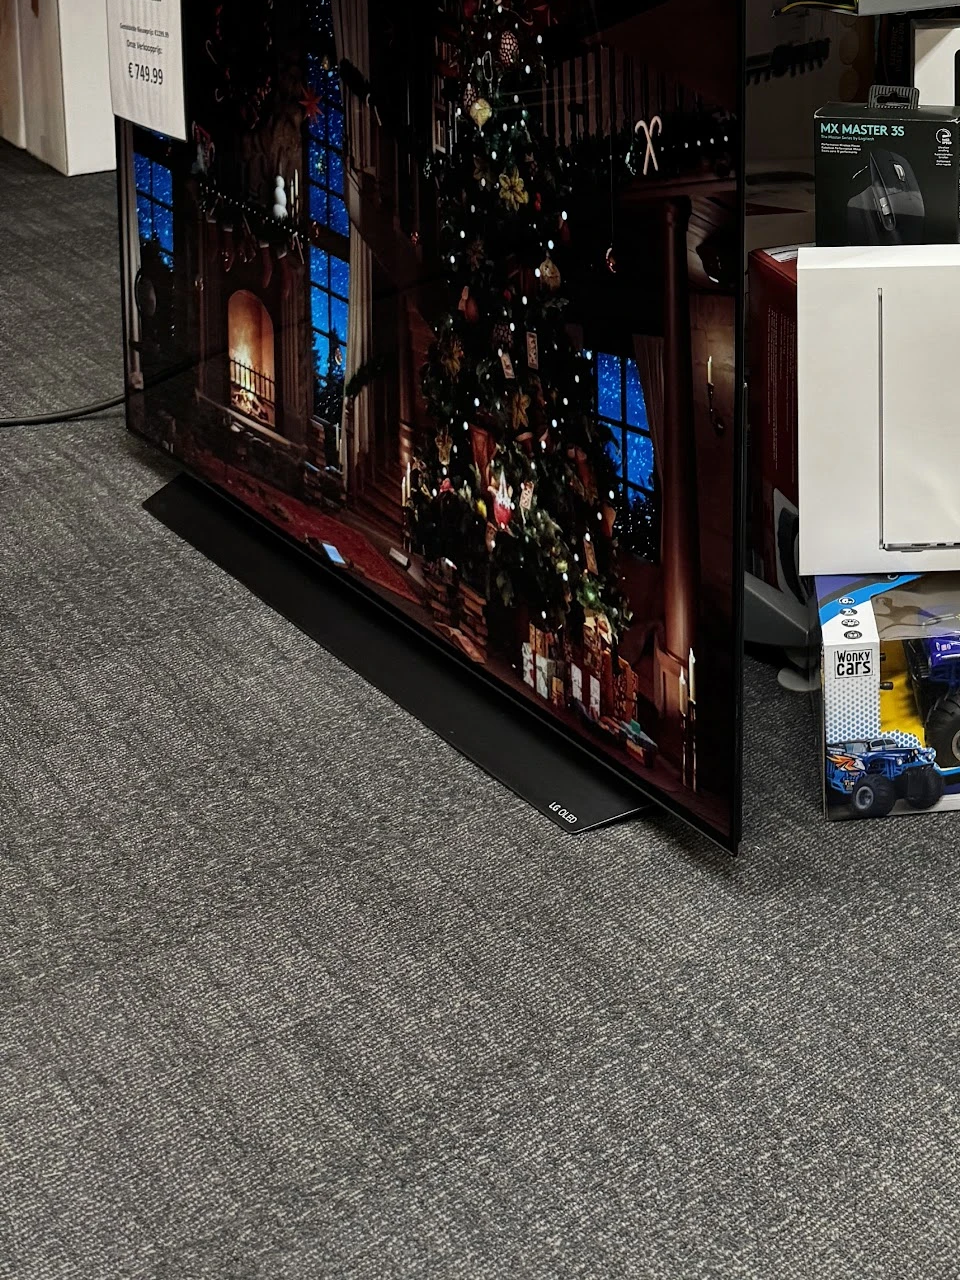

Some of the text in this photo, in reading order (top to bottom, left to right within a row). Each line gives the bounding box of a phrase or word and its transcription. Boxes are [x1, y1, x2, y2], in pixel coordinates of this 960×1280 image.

[128, 62, 164, 85] € 749.99
[820, 122, 905, 137] MX MASTER 3S
[548, 801, 578, 824] LG OLED
